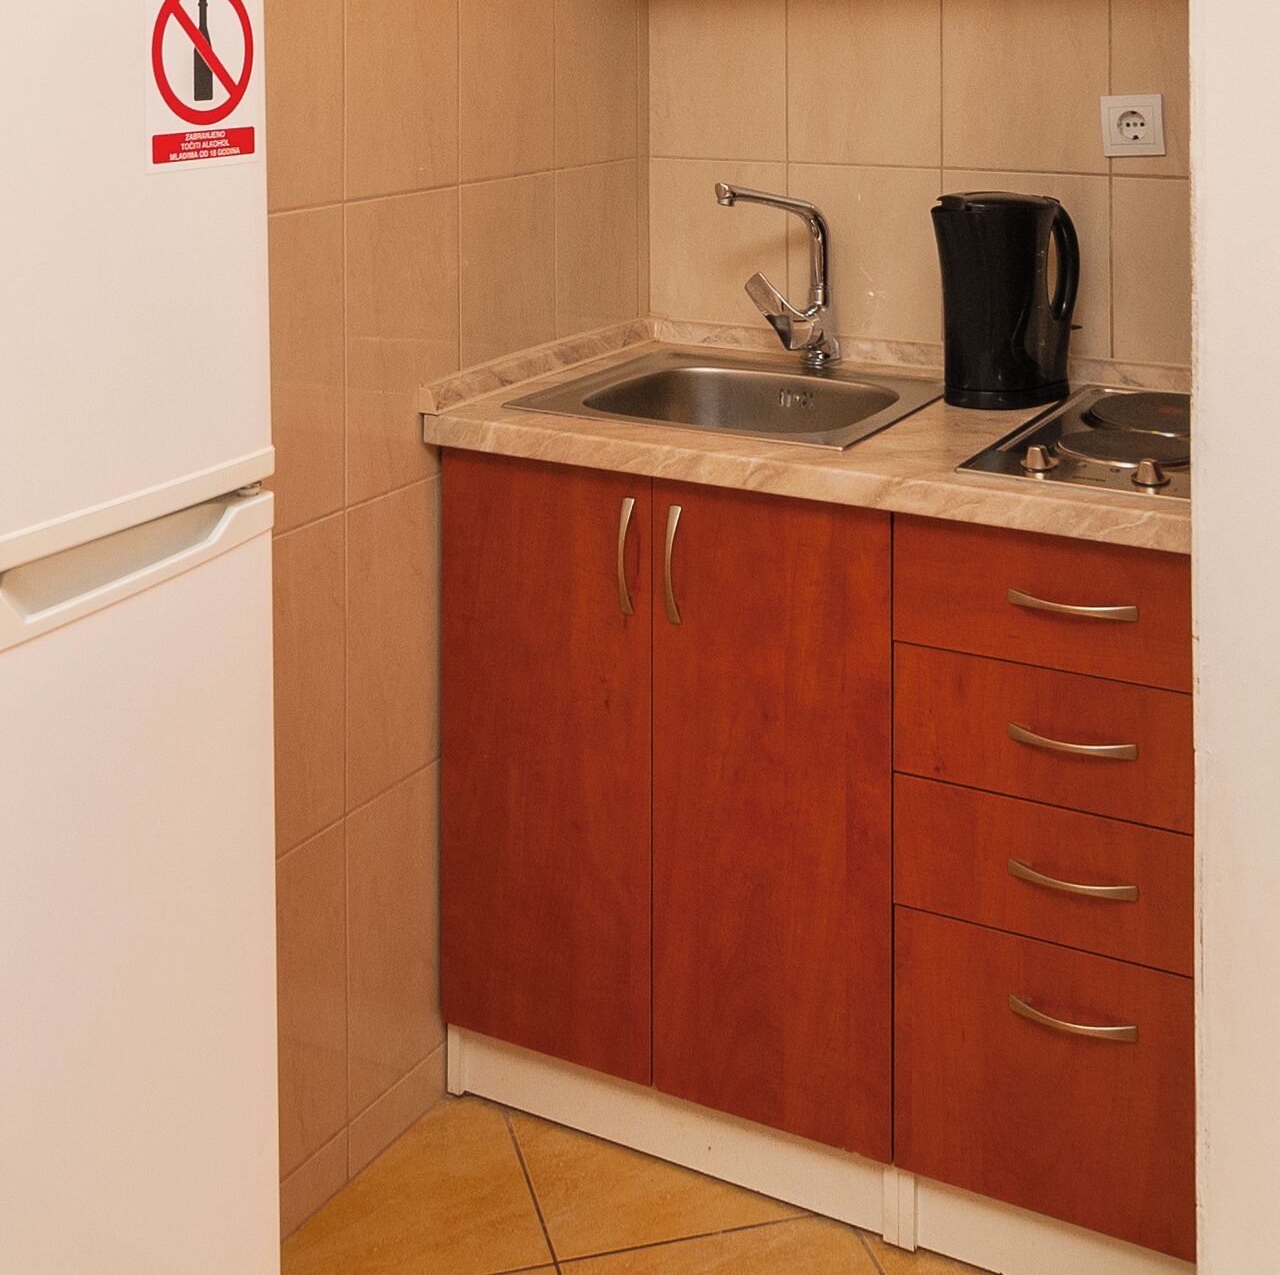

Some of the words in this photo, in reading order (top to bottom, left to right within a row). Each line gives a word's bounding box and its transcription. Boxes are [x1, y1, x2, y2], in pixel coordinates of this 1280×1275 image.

[185, 131, 226, 141] ZABRANJENO
[201, 139, 230, 148] ALKOHOL
[217, 147, 241, 156] GODINA
